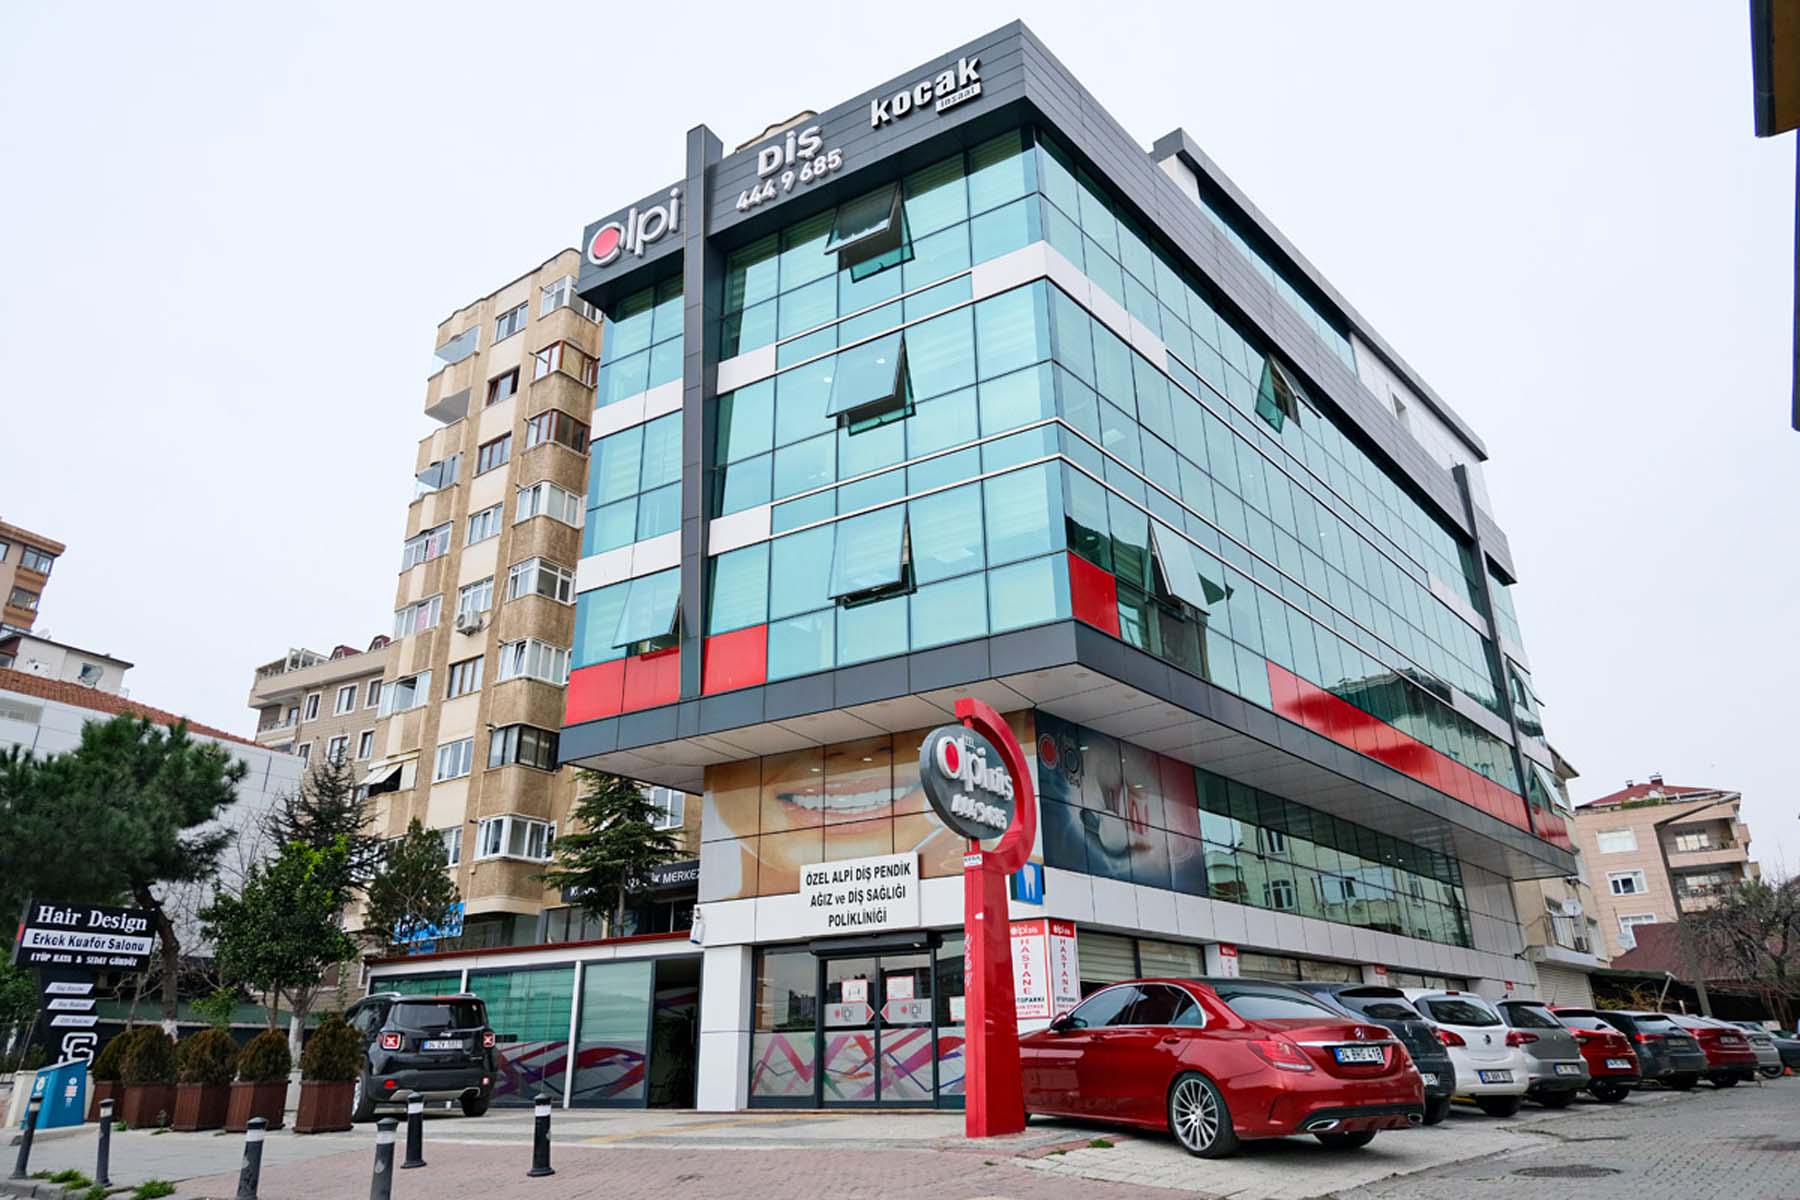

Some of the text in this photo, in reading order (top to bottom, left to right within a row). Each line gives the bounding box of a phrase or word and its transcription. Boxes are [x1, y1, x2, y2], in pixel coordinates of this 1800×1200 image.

[736, 148, 843, 213] 444 9 685
[806, 860, 911, 886] ÖZEL ALPİ DİŞ PENDİK
[810, 883, 906, 907] AĞIZ ve DİŞ SAĞLIĞI
[36, 905, 148, 933] Hair Design
[828, 907, 887, 928] POLİKLİNİĞİ
[32, 933, 65, 947] Erkek
[108, 939, 145, 951] Salonu
